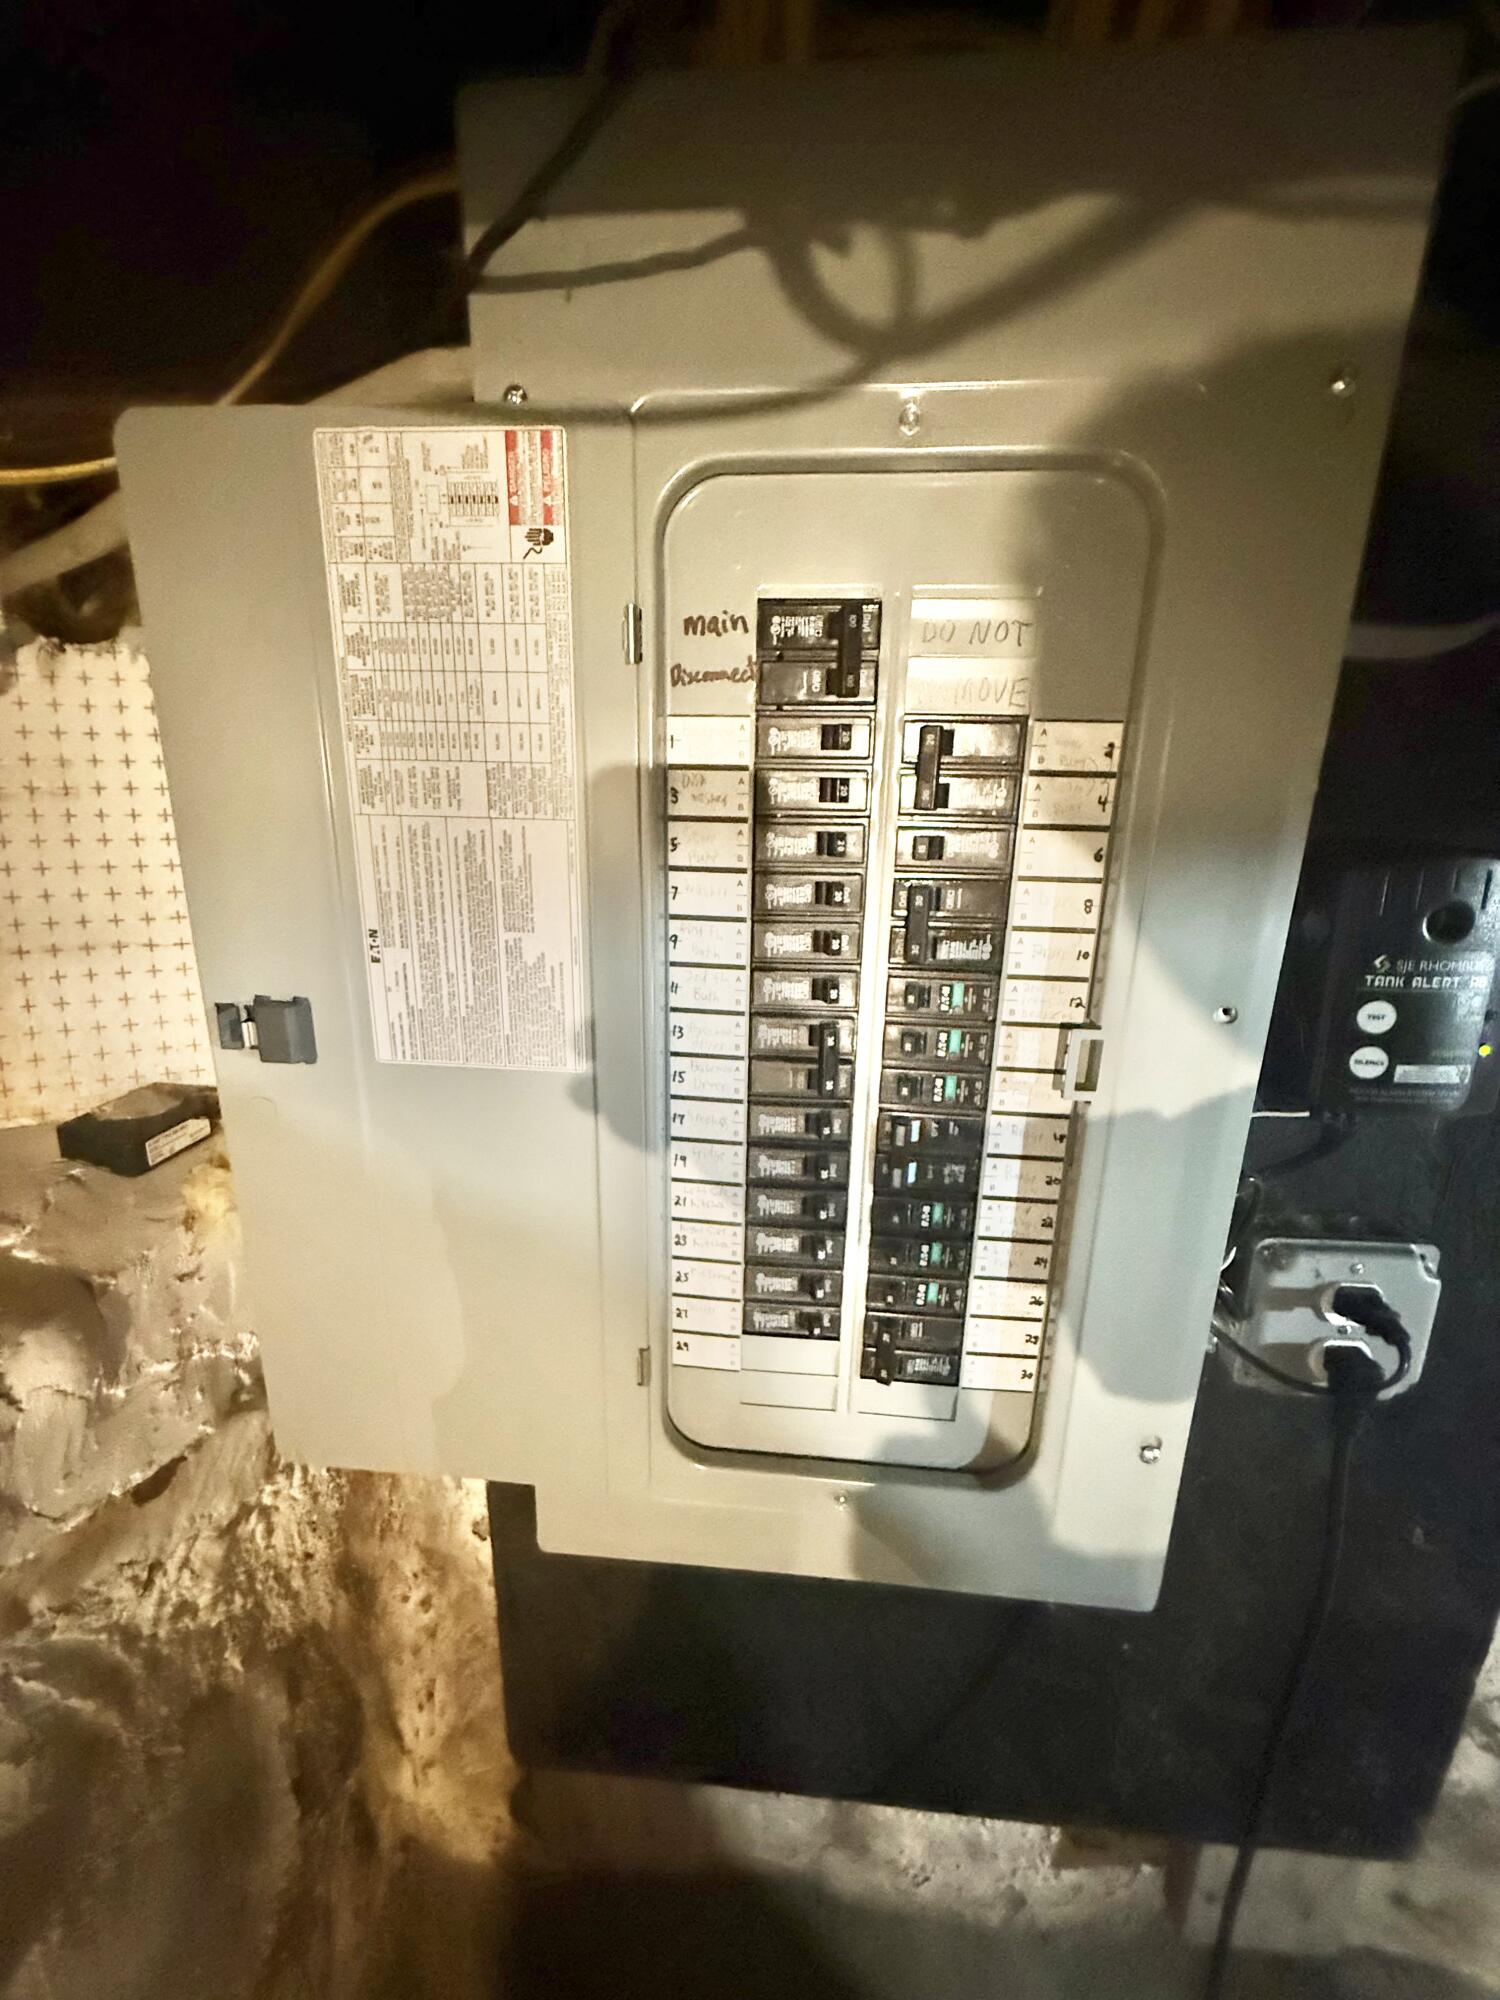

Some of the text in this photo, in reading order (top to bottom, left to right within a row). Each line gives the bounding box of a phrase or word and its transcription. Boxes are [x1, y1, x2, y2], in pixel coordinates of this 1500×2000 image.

[922, 619, 1034, 646] DO NOT
[670, 786, 679, 804] 3
[1098, 794, 1109, 813] 4
[670, 837, 678, 852] 5
[1094, 847, 1103, 863] 6
[671, 885, 678, 900] 7
[1084, 899, 1093, 914] 8
[670, 934, 678, 949] 9
[1076, 950, 1090, 961] 10
[671, 981, 678, 994] 11
[1364, 975, 1405, 988] TANK
[1412, 976, 1460, 989] ALERT
[1069, 997, 1086, 1009] 12
[672, 1025, 684, 1039] 13
[672, 1070, 686, 1083] 15
[672, 1113, 685, 1125] 17
[674, 1153, 687, 1167] 19
[1045, 1175, 1061, 1186] 20
[674, 1195, 686, 1206] 21
[674, 1234, 687, 1246] 23
[1034, 1257, 1048, 1269] 24
[675, 1271, 688, 1282] 25
[1029, 1296, 1045, 1306] 26
[676, 1341, 689, 1351] 29
[1021, 1369, 1033, 1379] 30
